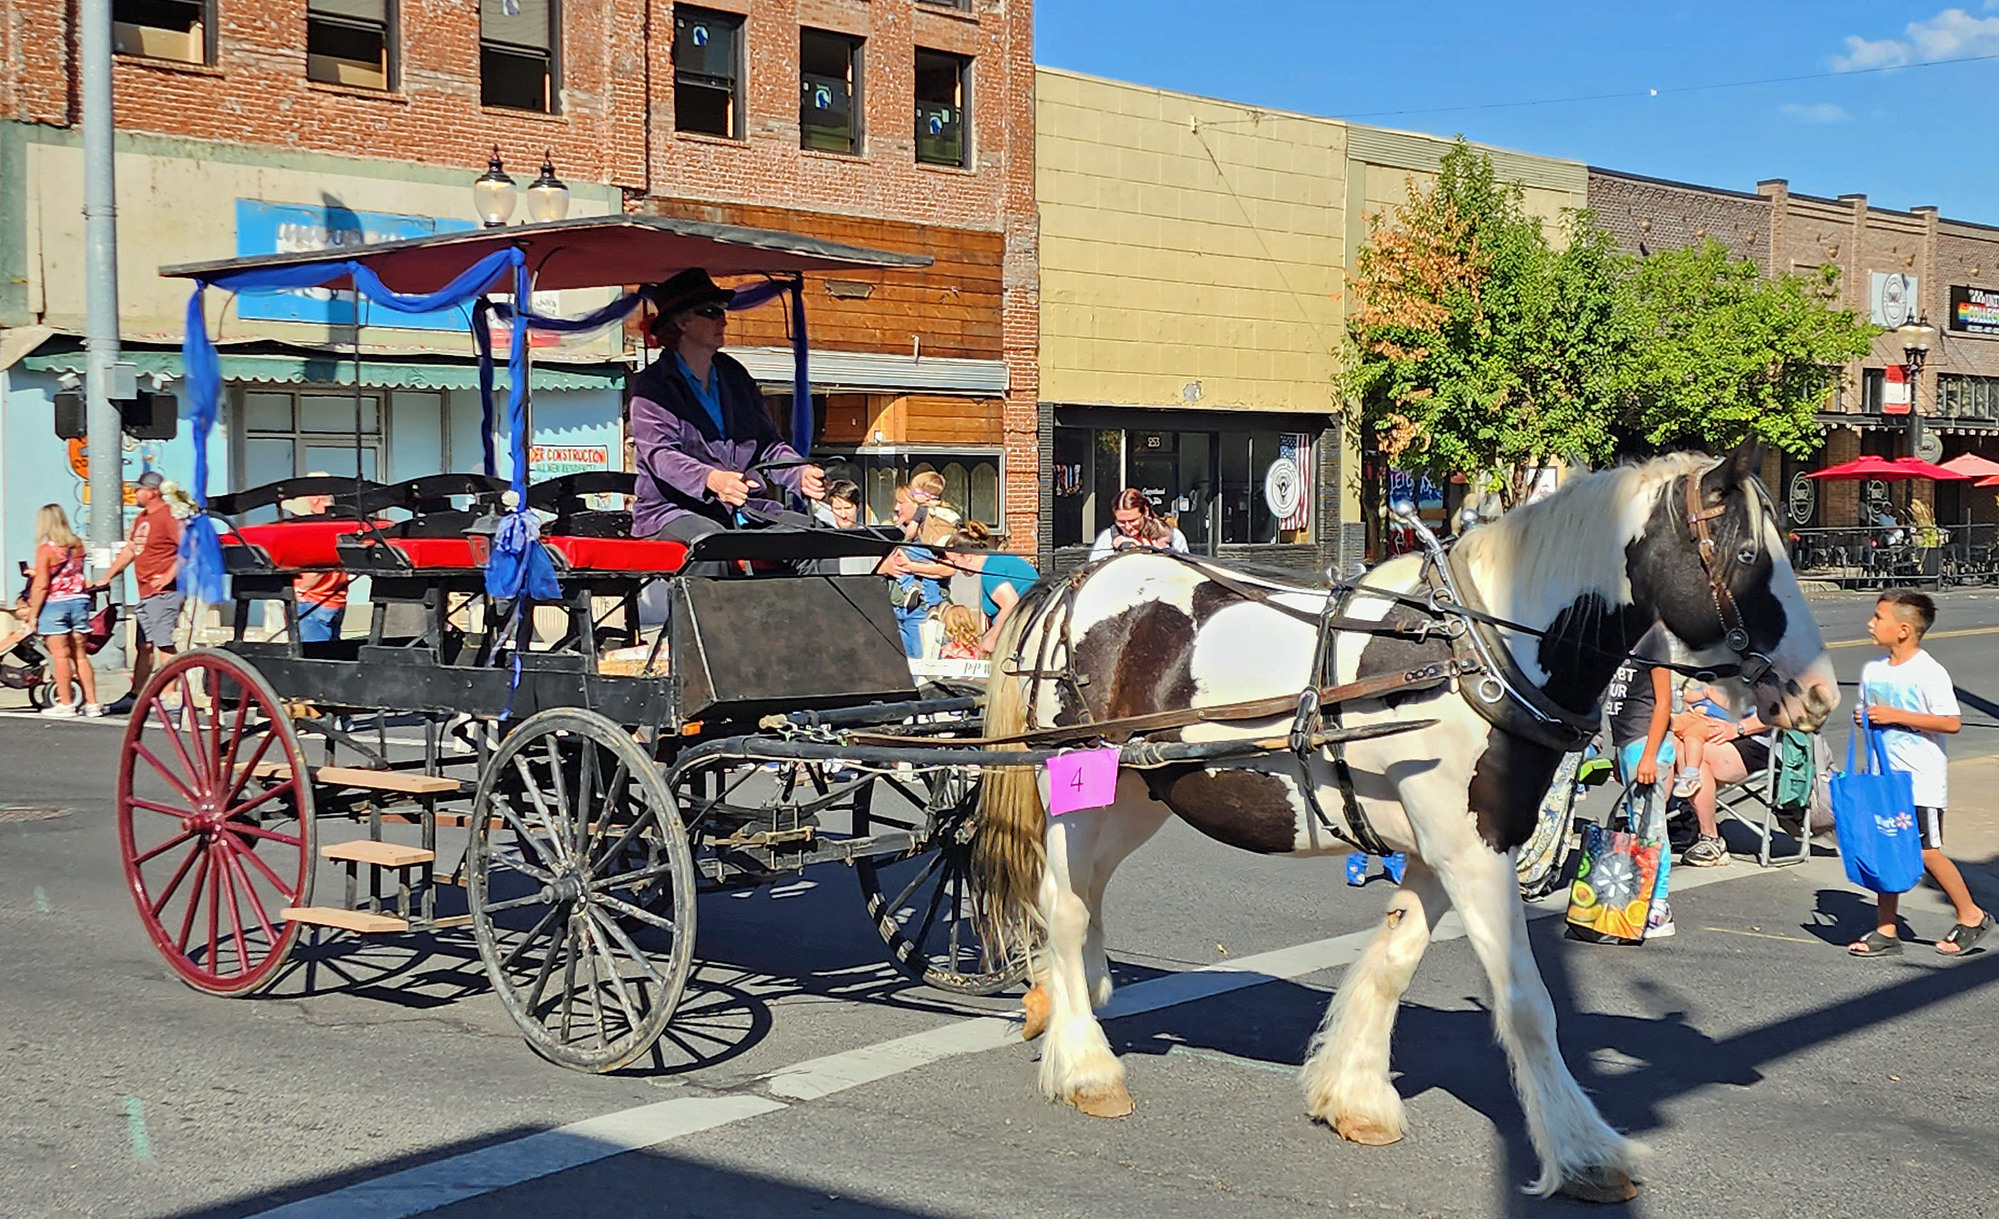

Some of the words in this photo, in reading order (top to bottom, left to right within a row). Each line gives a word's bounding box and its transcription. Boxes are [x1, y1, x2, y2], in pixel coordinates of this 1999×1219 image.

[1147, 437, 1161, 447] 253
[1614, 666, 1638, 682] BT
[1610, 684, 1628, 698] UR
[1070, 766, 1084, 792] 4
